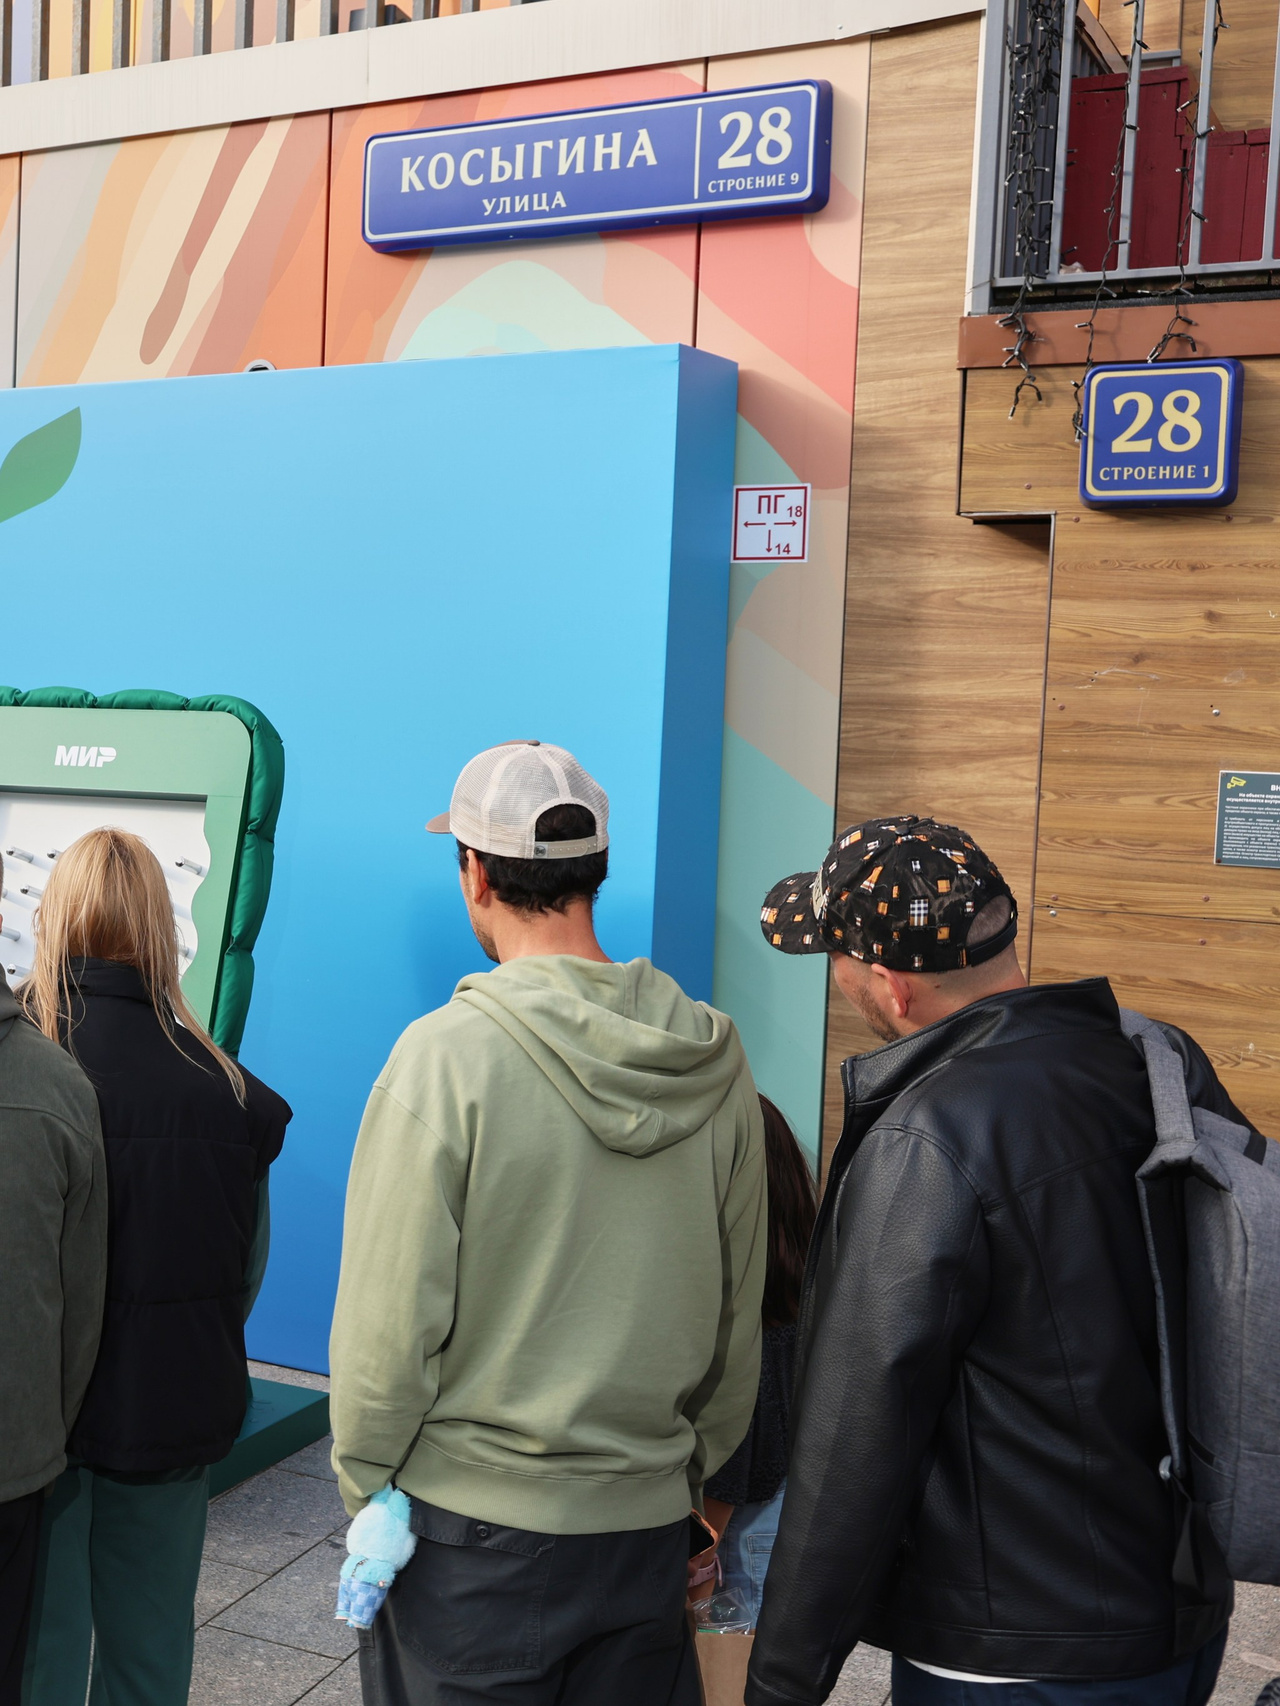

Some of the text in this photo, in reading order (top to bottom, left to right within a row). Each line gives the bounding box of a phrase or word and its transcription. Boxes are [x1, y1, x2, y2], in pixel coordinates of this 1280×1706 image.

[716, 106, 794, 170] 28
[399, 128, 658, 194] КОСЫГИНА
[707, 172, 800, 195] СТРОЕНИЕ 9
[482, 190, 567, 217] УЛИЦА
[1111, 389, 1203, 454] 28
[1099, 465, 1209, 481] СТРОЕНИЕ 1
[757, 494, 785, 514] ПГ
[787, 505, 803, 518] 18
[775, 543, 791, 555] 14
[54, 745, 117, 768] МИР
